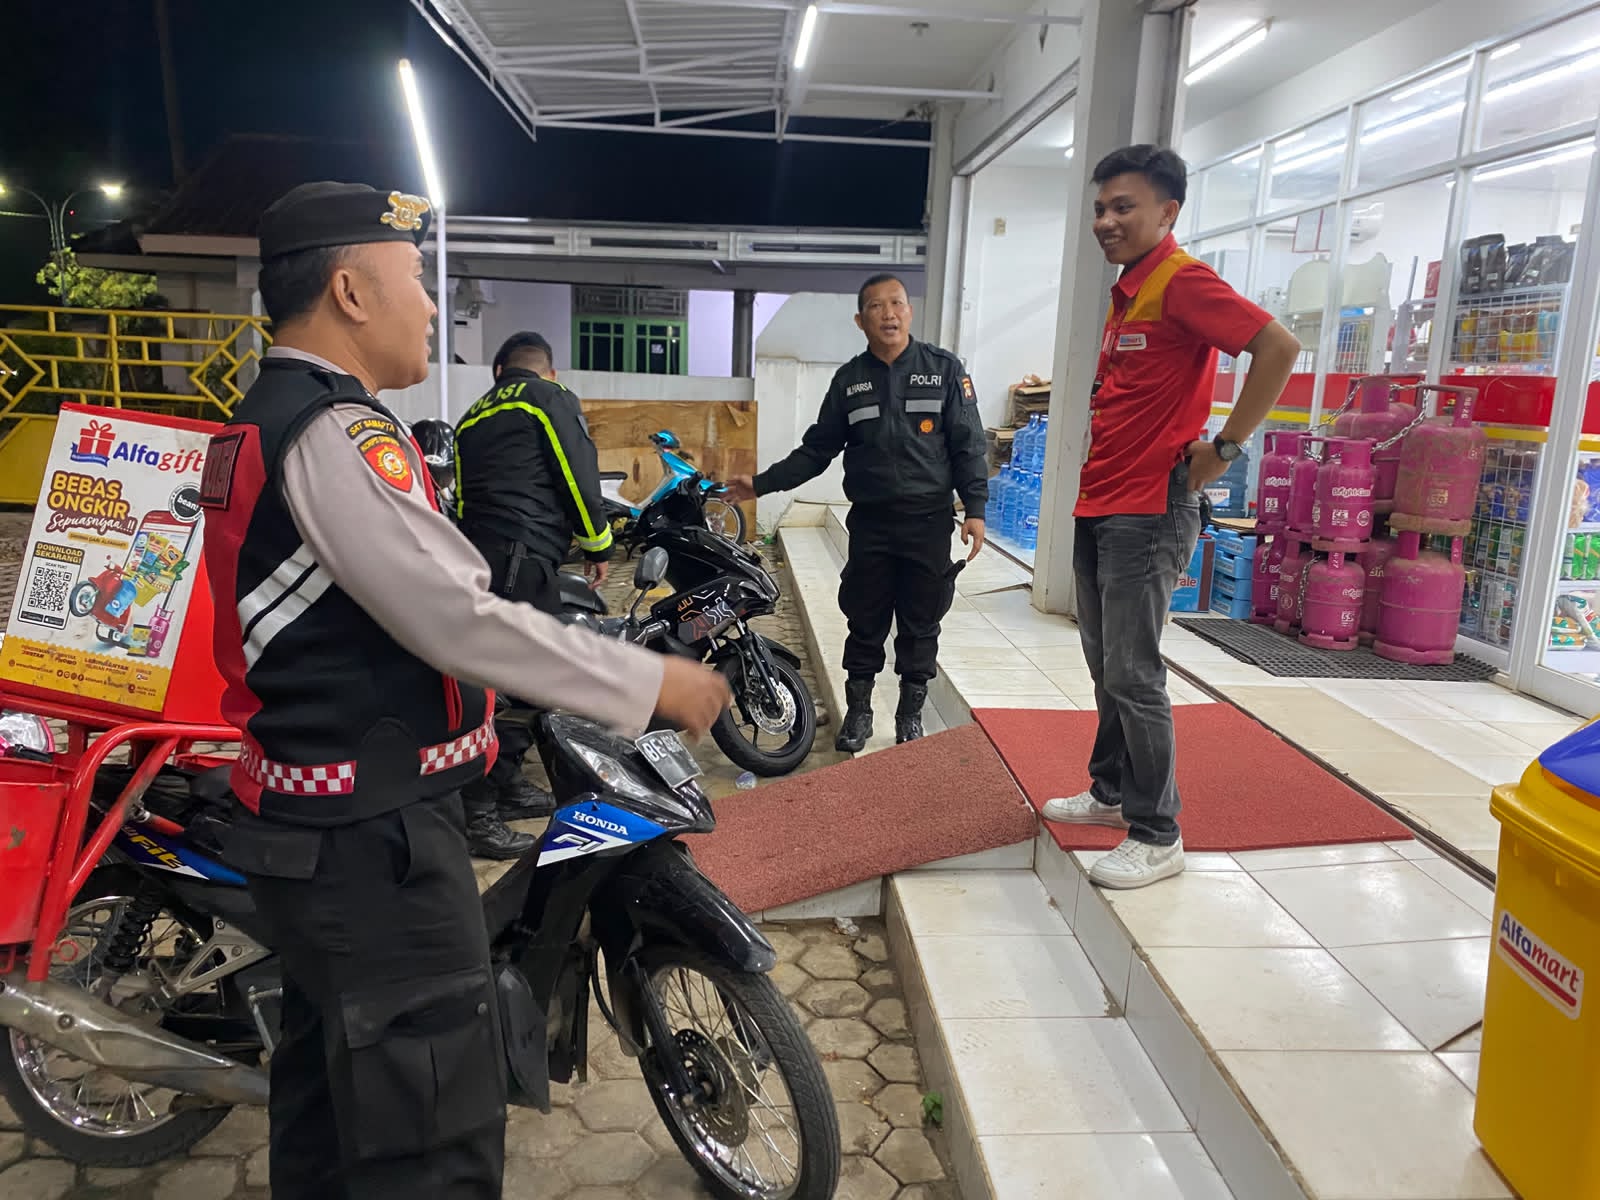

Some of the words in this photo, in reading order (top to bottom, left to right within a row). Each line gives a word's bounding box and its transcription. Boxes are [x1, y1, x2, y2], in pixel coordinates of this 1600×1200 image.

[910, 374, 942, 386] POLRI
[470, 382, 527, 414] OLISI
[113, 442, 205, 473] Alfagift
[53, 473, 122, 499] BEBAS
[50, 491, 128, 520] ONGKIR
[35, 550, 81, 564] SEKARANG!
[37, 543, 83, 557] DOWNLOAD
[1179, 578, 1197, 587] ale
[642, 738, 667, 762] BE
[572, 810, 629, 836] HONDA
[1501, 913, 1580, 993] Alfamart
